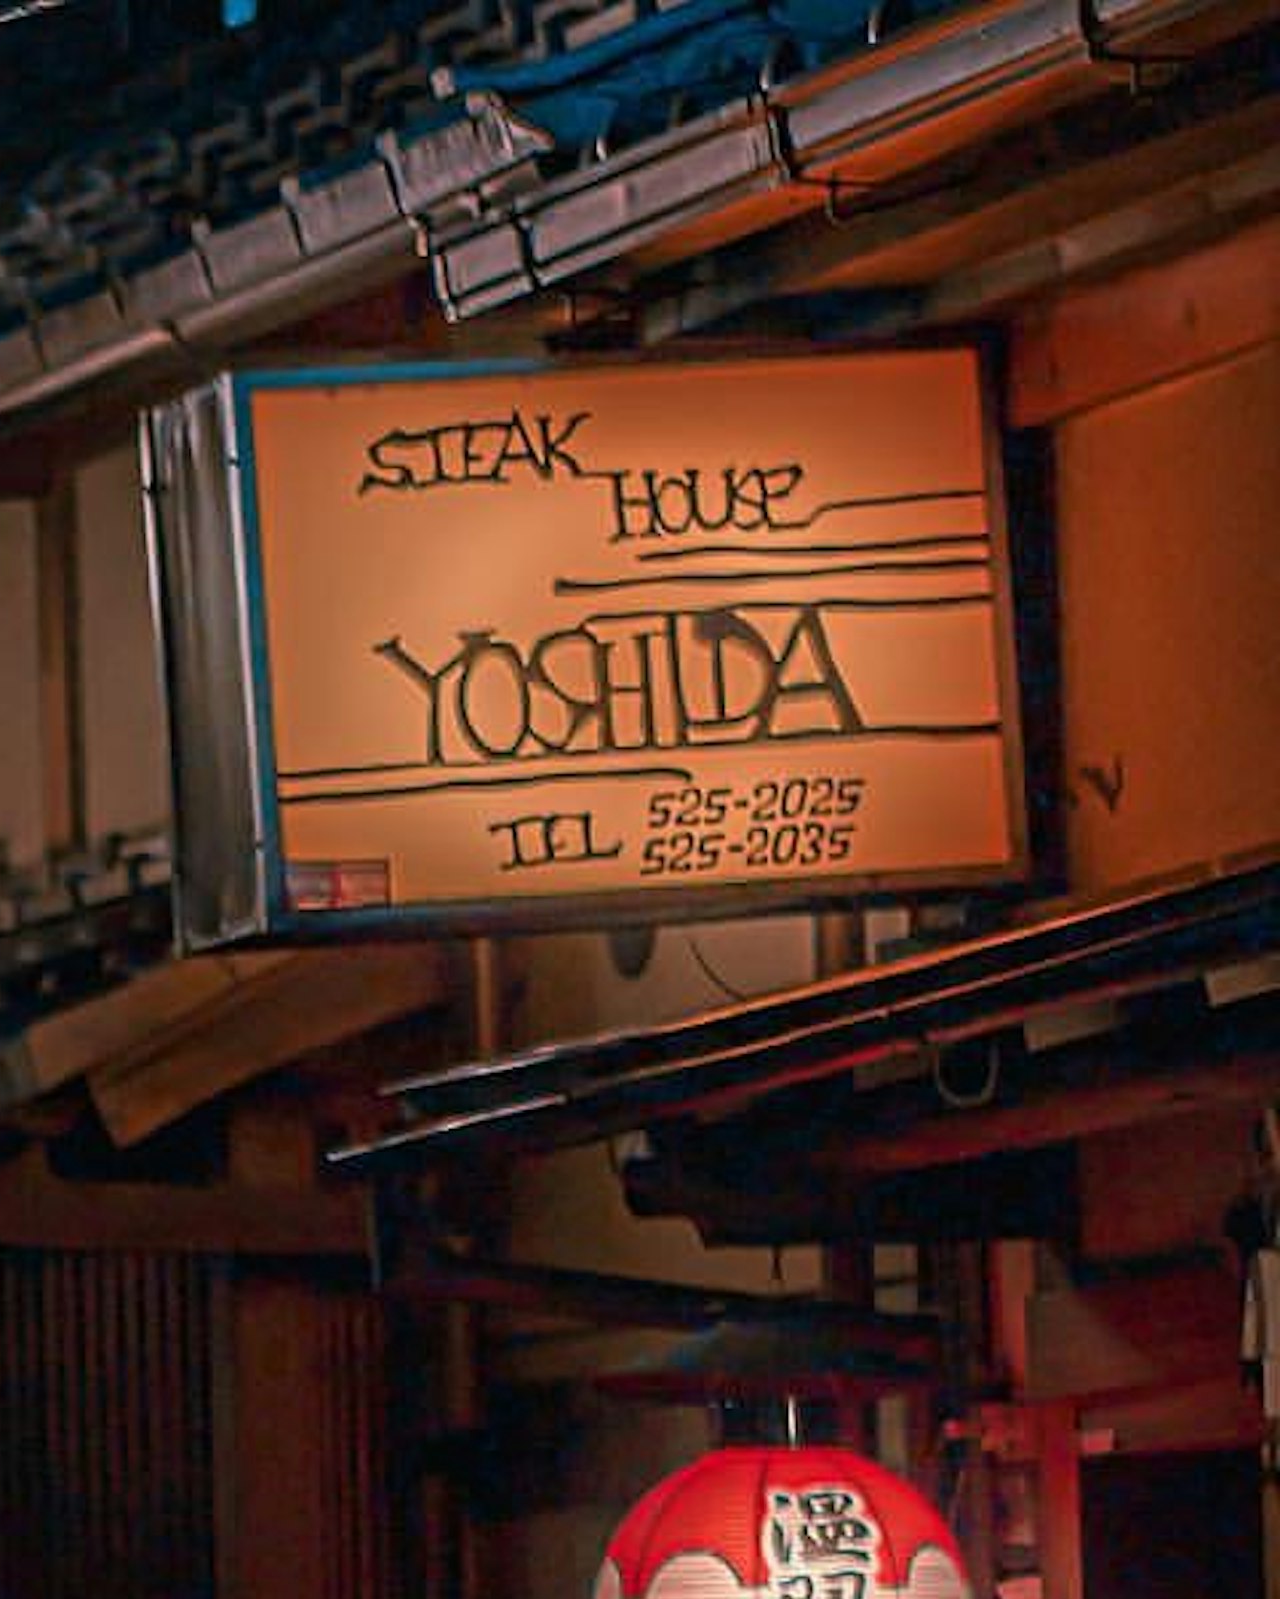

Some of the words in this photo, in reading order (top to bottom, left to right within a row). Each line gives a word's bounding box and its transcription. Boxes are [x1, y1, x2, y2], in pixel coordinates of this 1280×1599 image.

[358, 404, 592, 506] STEAK
[608, 461, 812, 544] HOUSE
[372, 603, 864, 766] YOSHIDA
[487, 809, 624, 873] TEL
[647, 778, 866, 830] 525-2025
[639, 822, 856, 877] 525-2035
